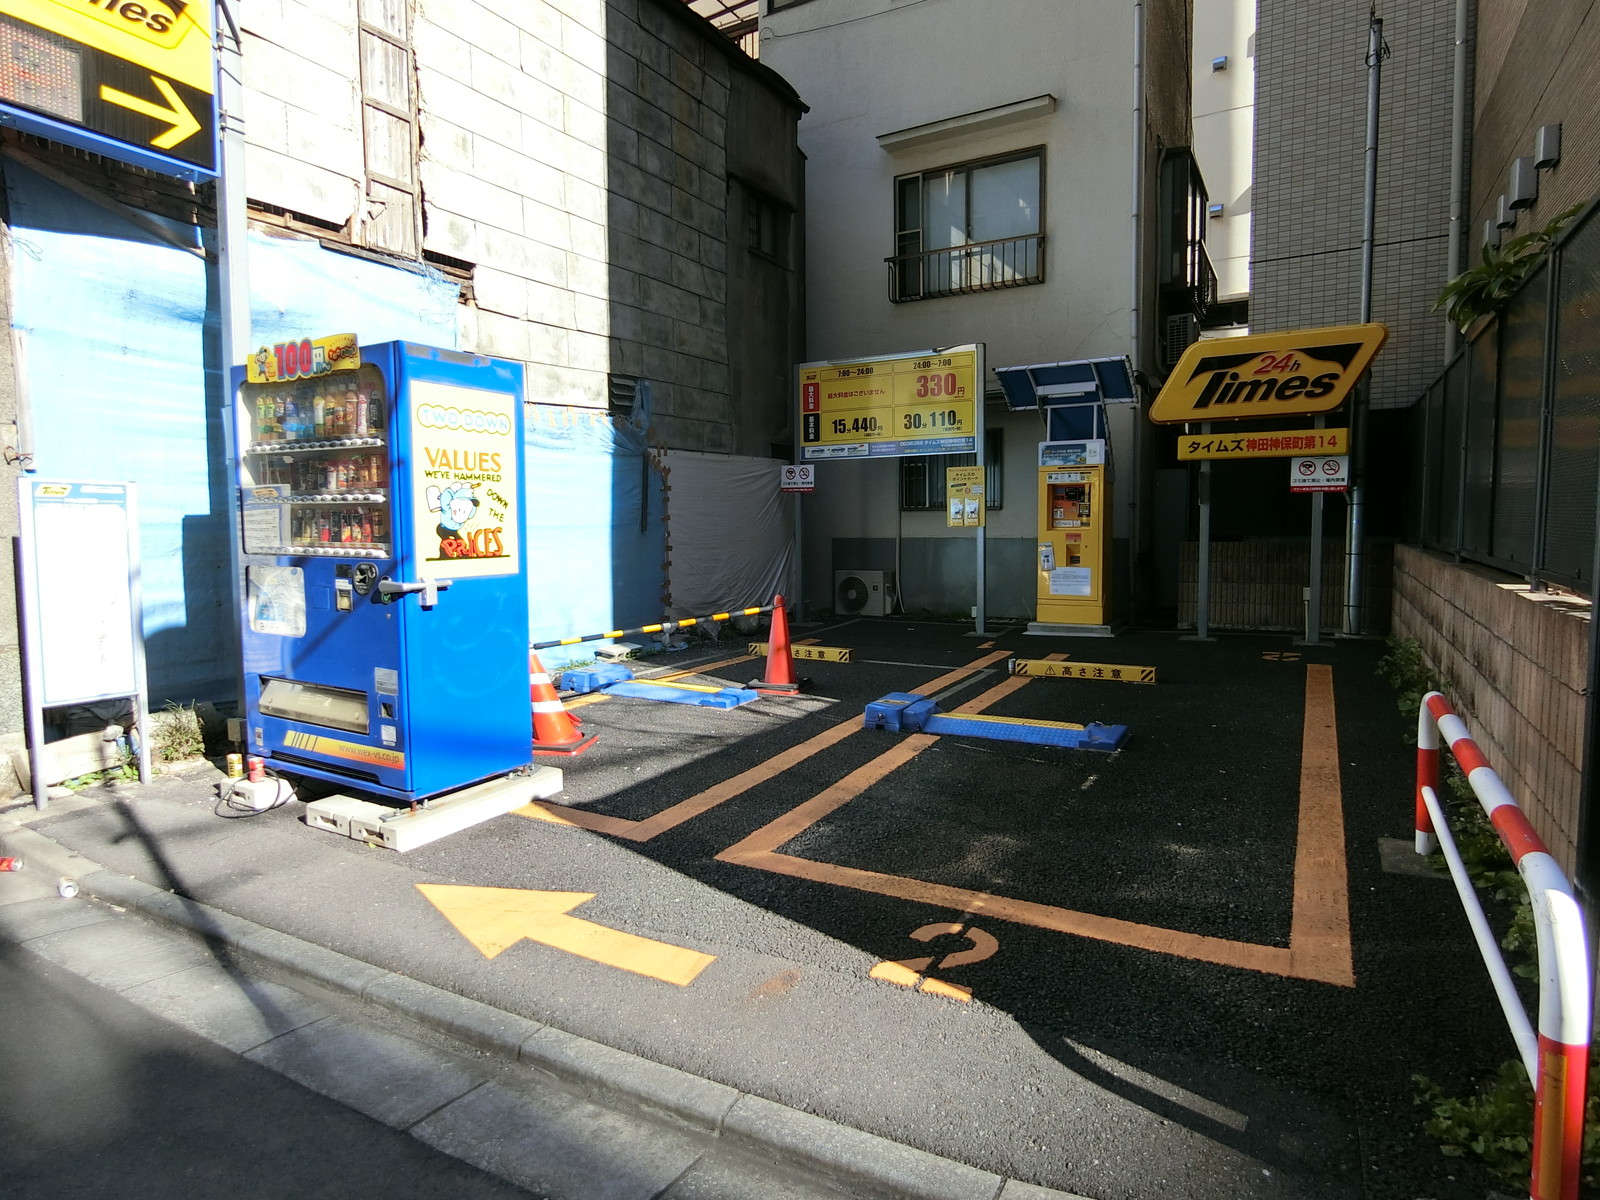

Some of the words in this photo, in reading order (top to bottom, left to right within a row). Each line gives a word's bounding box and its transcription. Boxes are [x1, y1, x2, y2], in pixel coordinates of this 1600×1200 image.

[1253, 353, 1300, 375] 24h
[1193, 369, 1340, 408] Times
[422, 409, 458, 424] TWO
[464, 413, 508, 430] DOWN
[424, 447, 502, 473] VALUES
[454, 472, 502, 483] HAMMERED
[486, 488, 509, 509] DOWN
[488, 507, 504, 522] THE
[441, 526, 504, 558] PRICES
[870, 922, 999, 1003] 2
